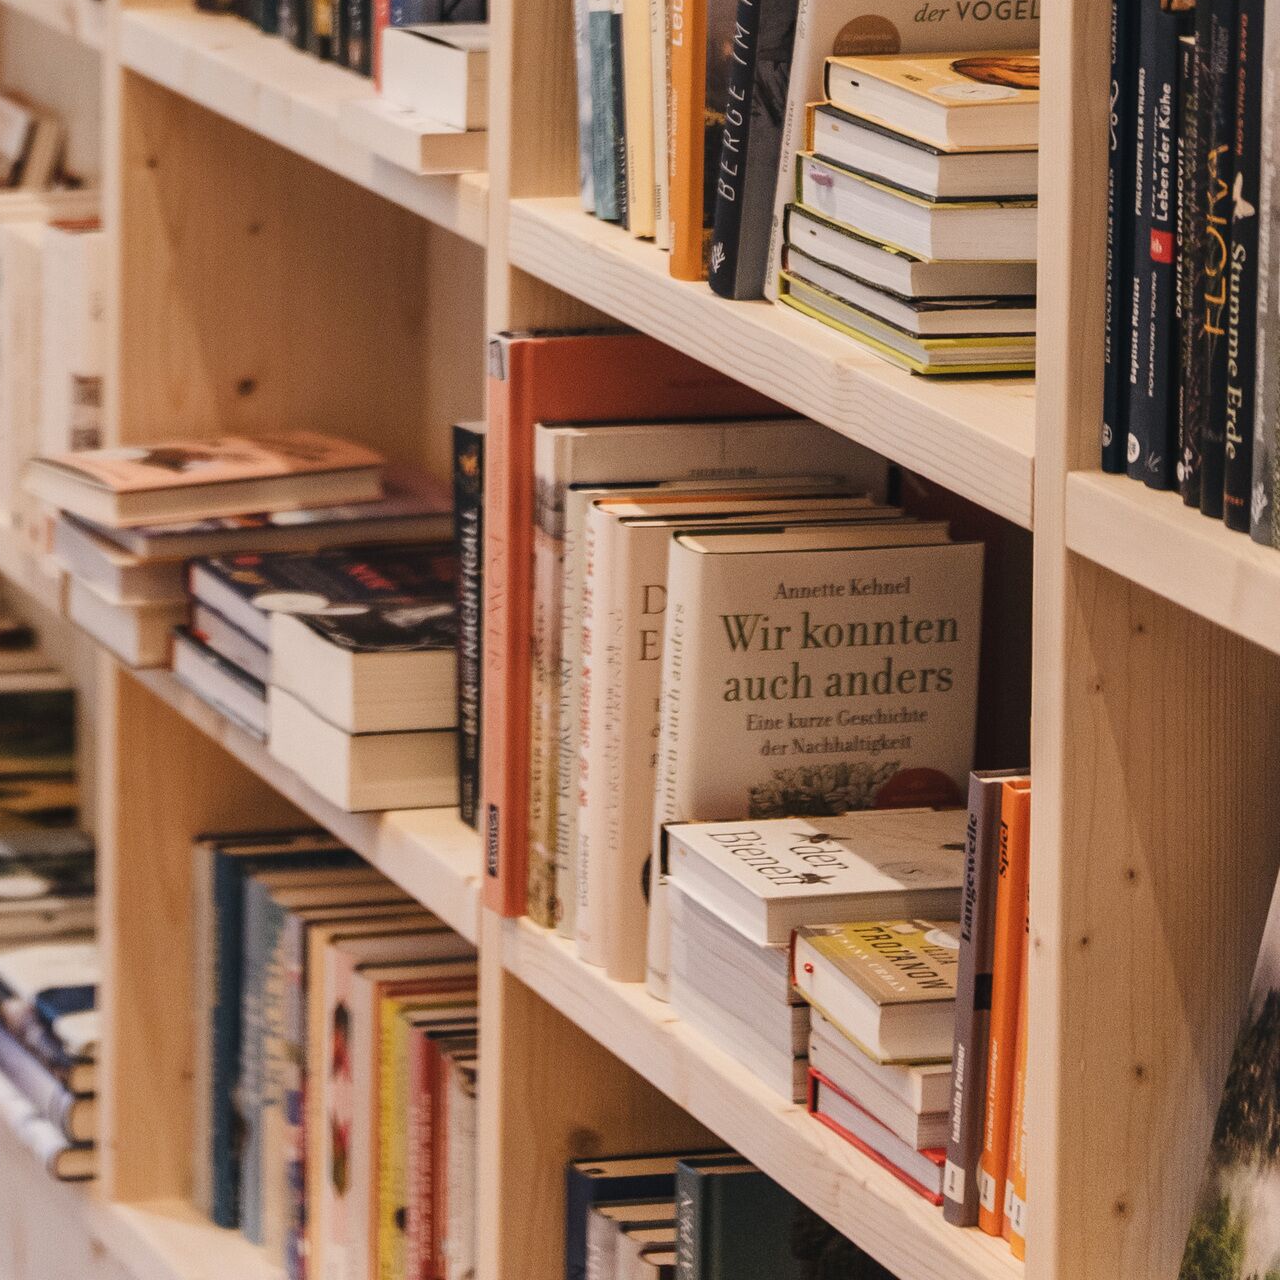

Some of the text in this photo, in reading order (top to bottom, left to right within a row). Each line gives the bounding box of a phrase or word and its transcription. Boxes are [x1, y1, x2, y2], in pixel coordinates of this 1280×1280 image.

[731, 20, 752, 67] IM
[913, 2, 951, 23] der
[717, 81, 746, 203] BERGE
[1134, 67, 1147, 217] PHILOSOPHIE DER WILDNIS
[1157, 82, 1174, 222] Leben der Kühe
[1175, 136, 1187, 319] DANIEL CHAMOVITZ
[1203, 145, 1230, 338] FLORA
[1128, 276, 1142, 384] Baptiste Morizot
[1147, 271, 1159, 398] ROSAMUND YOUNG
[1225, 239, 1247, 459] Stumme Erde
[461, 507, 479, 659] NACHTIGALL
[775, 575, 911, 600] Annette Kehnel
[718, 611, 792, 653] Wir
[799, 609, 960, 649] konnten
[666, 603, 685, 742] auch anders
[722, 655, 955, 702] auch anders
[745, 705, 929, 731] Eine kurze Geschichte
[759, 733, 913, 757] der Nachhaltigkeit
[706, 829, 808, 886] Bienen
[788, 842, 849, 870] der
[961, 811, 978, 943] Langeweile
[998, 820, 1010, 879] Spiel
[851, 925, 954, 990] TROJANOW
[951, 1088, 963, 1144] Isabella
